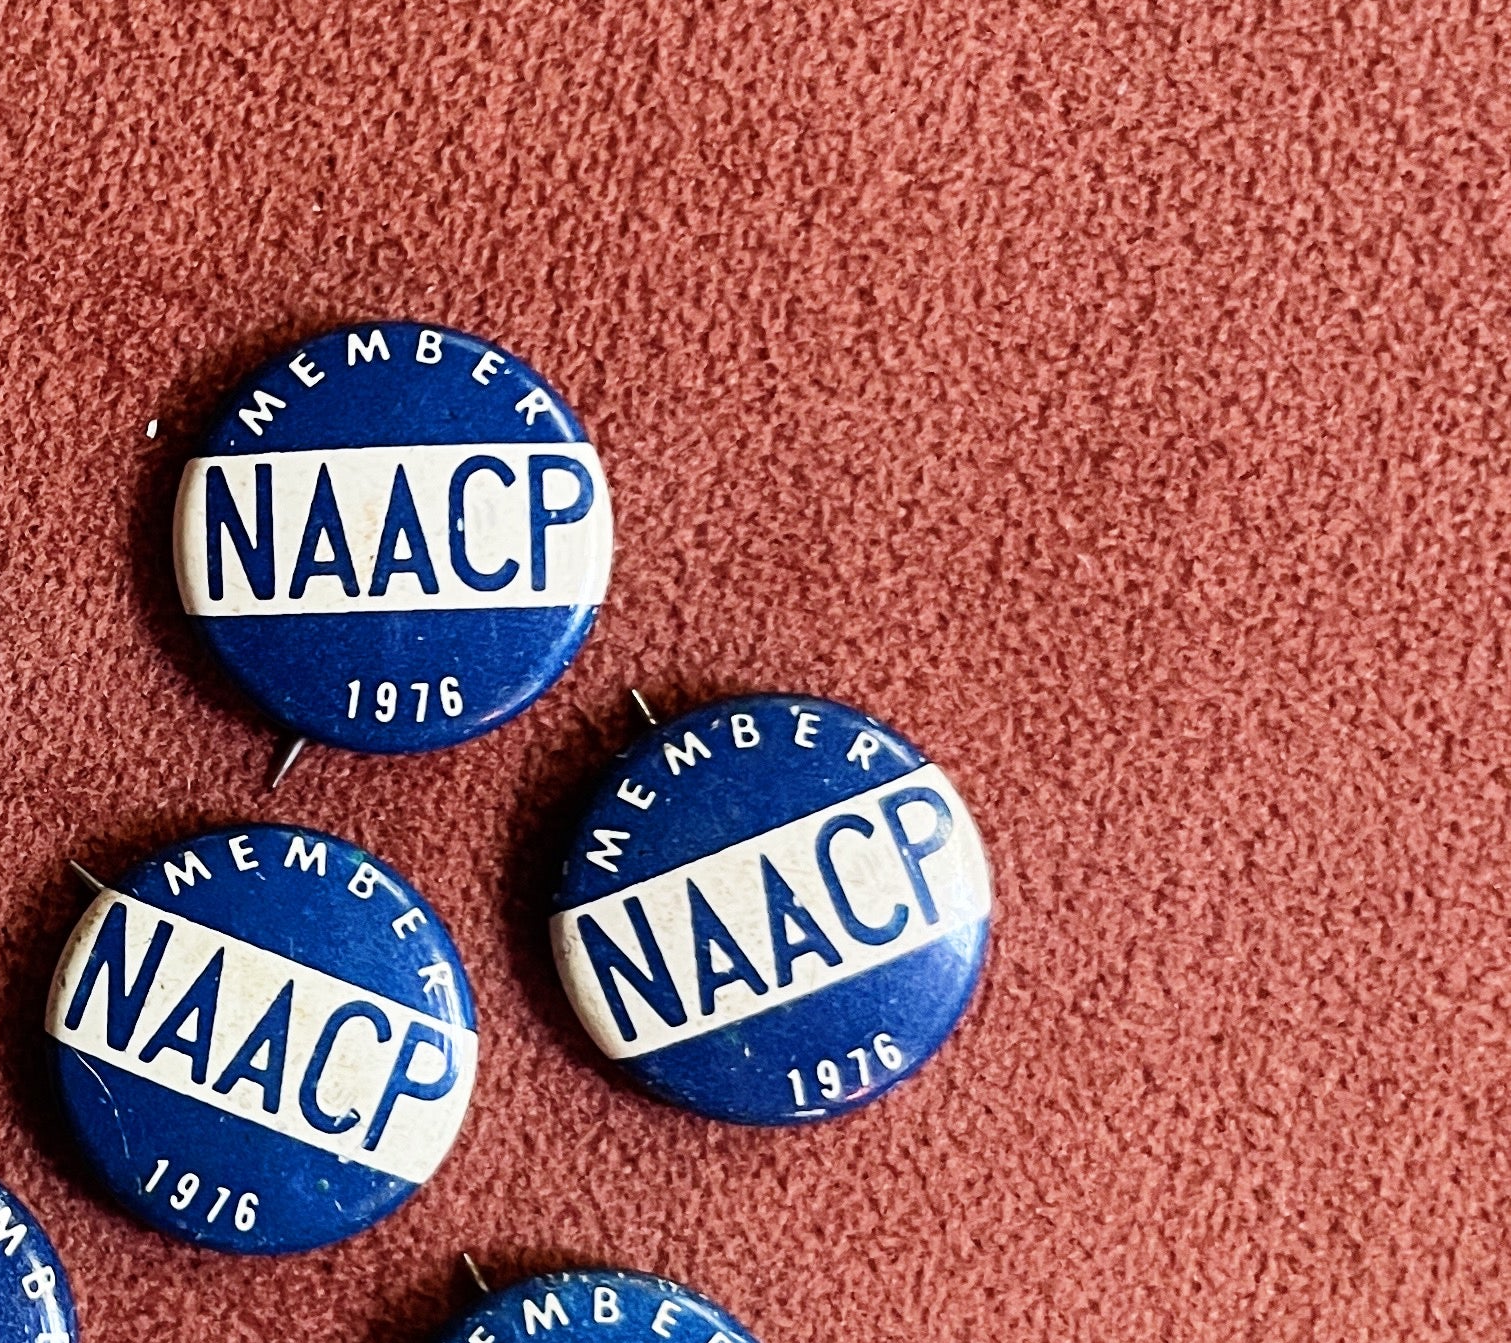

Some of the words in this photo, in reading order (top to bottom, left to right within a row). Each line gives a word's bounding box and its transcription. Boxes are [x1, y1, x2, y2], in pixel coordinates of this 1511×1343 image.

[239, 329, 553, 435] MEMBER
[206, 455, 594, 601] NAACP
[348, 677, 463, 722] 1976
[587, 713, 879, 872] MEMBER
[164, 835, 452, 993] MEMBER
[577, 786, 953, 1042] NAACP
[64, 902, 459, 1151] NAACP
[788, 1033, 902, 1106] 1976
[145, 1159, 259, 1232] 1976
